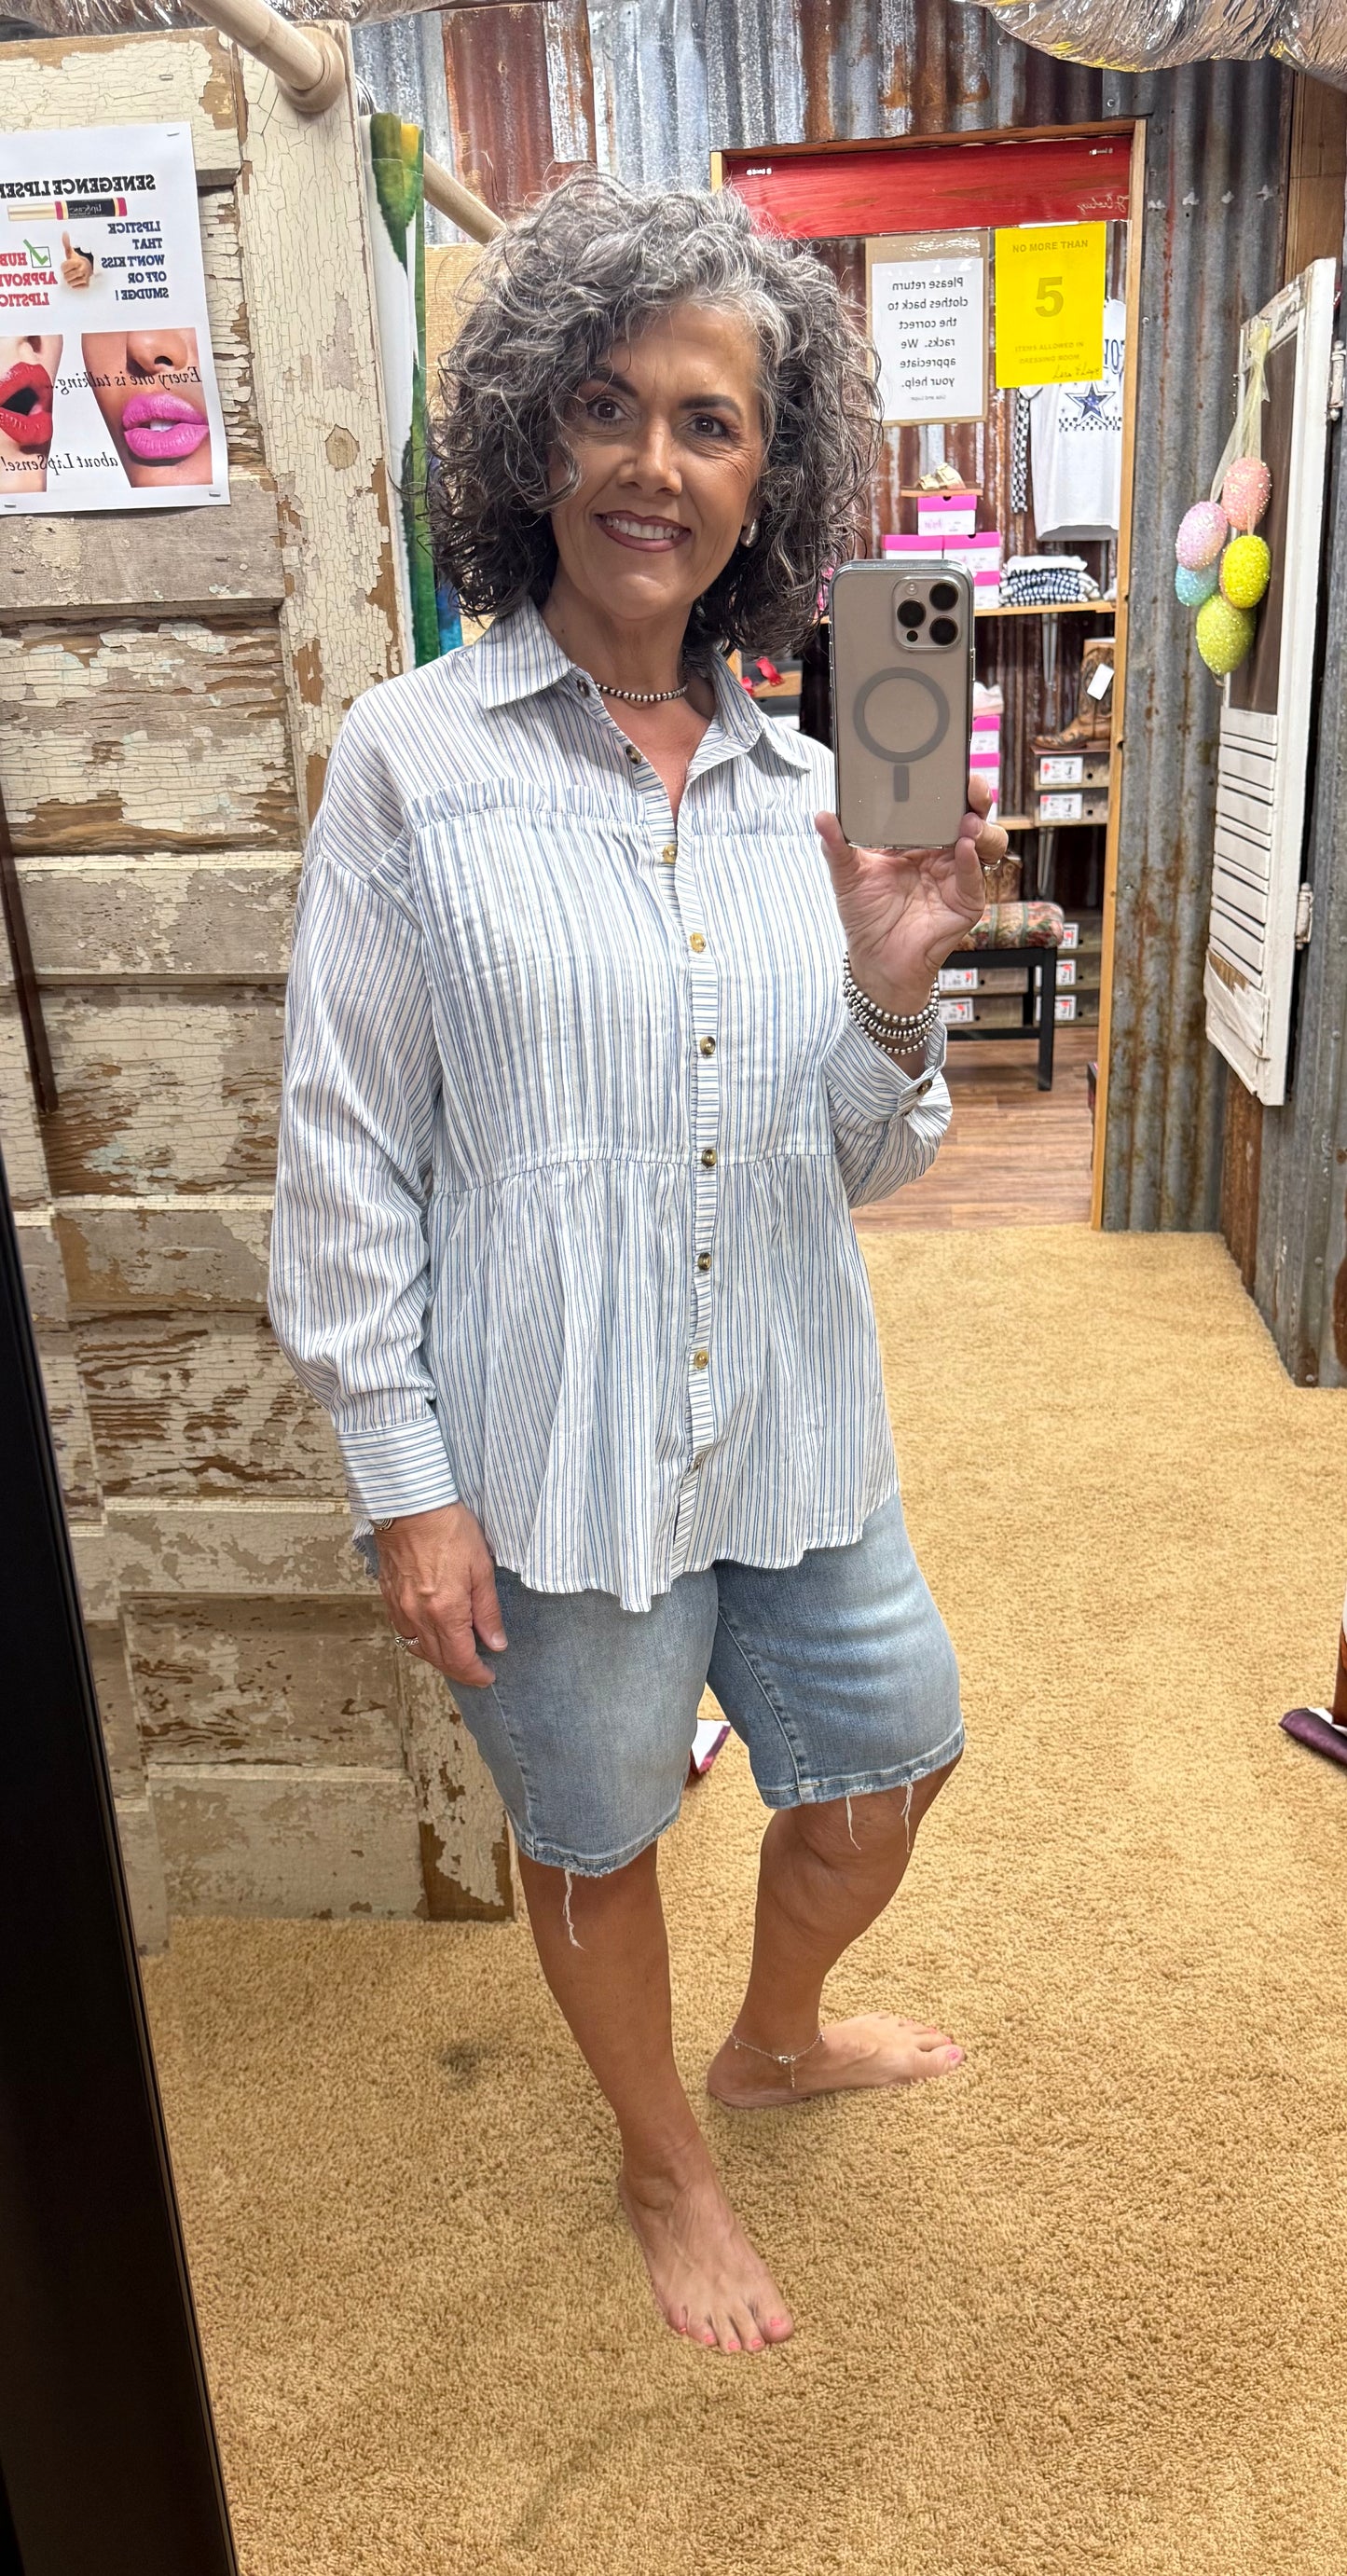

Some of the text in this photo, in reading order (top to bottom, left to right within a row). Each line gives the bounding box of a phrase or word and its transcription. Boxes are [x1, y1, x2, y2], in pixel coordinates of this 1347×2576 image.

[1012, 240, 1088, 253] NO MORE THAN
[1035, 276, 1064, 318] 5
[1039, 342, 1074, 351] ALLOWED
